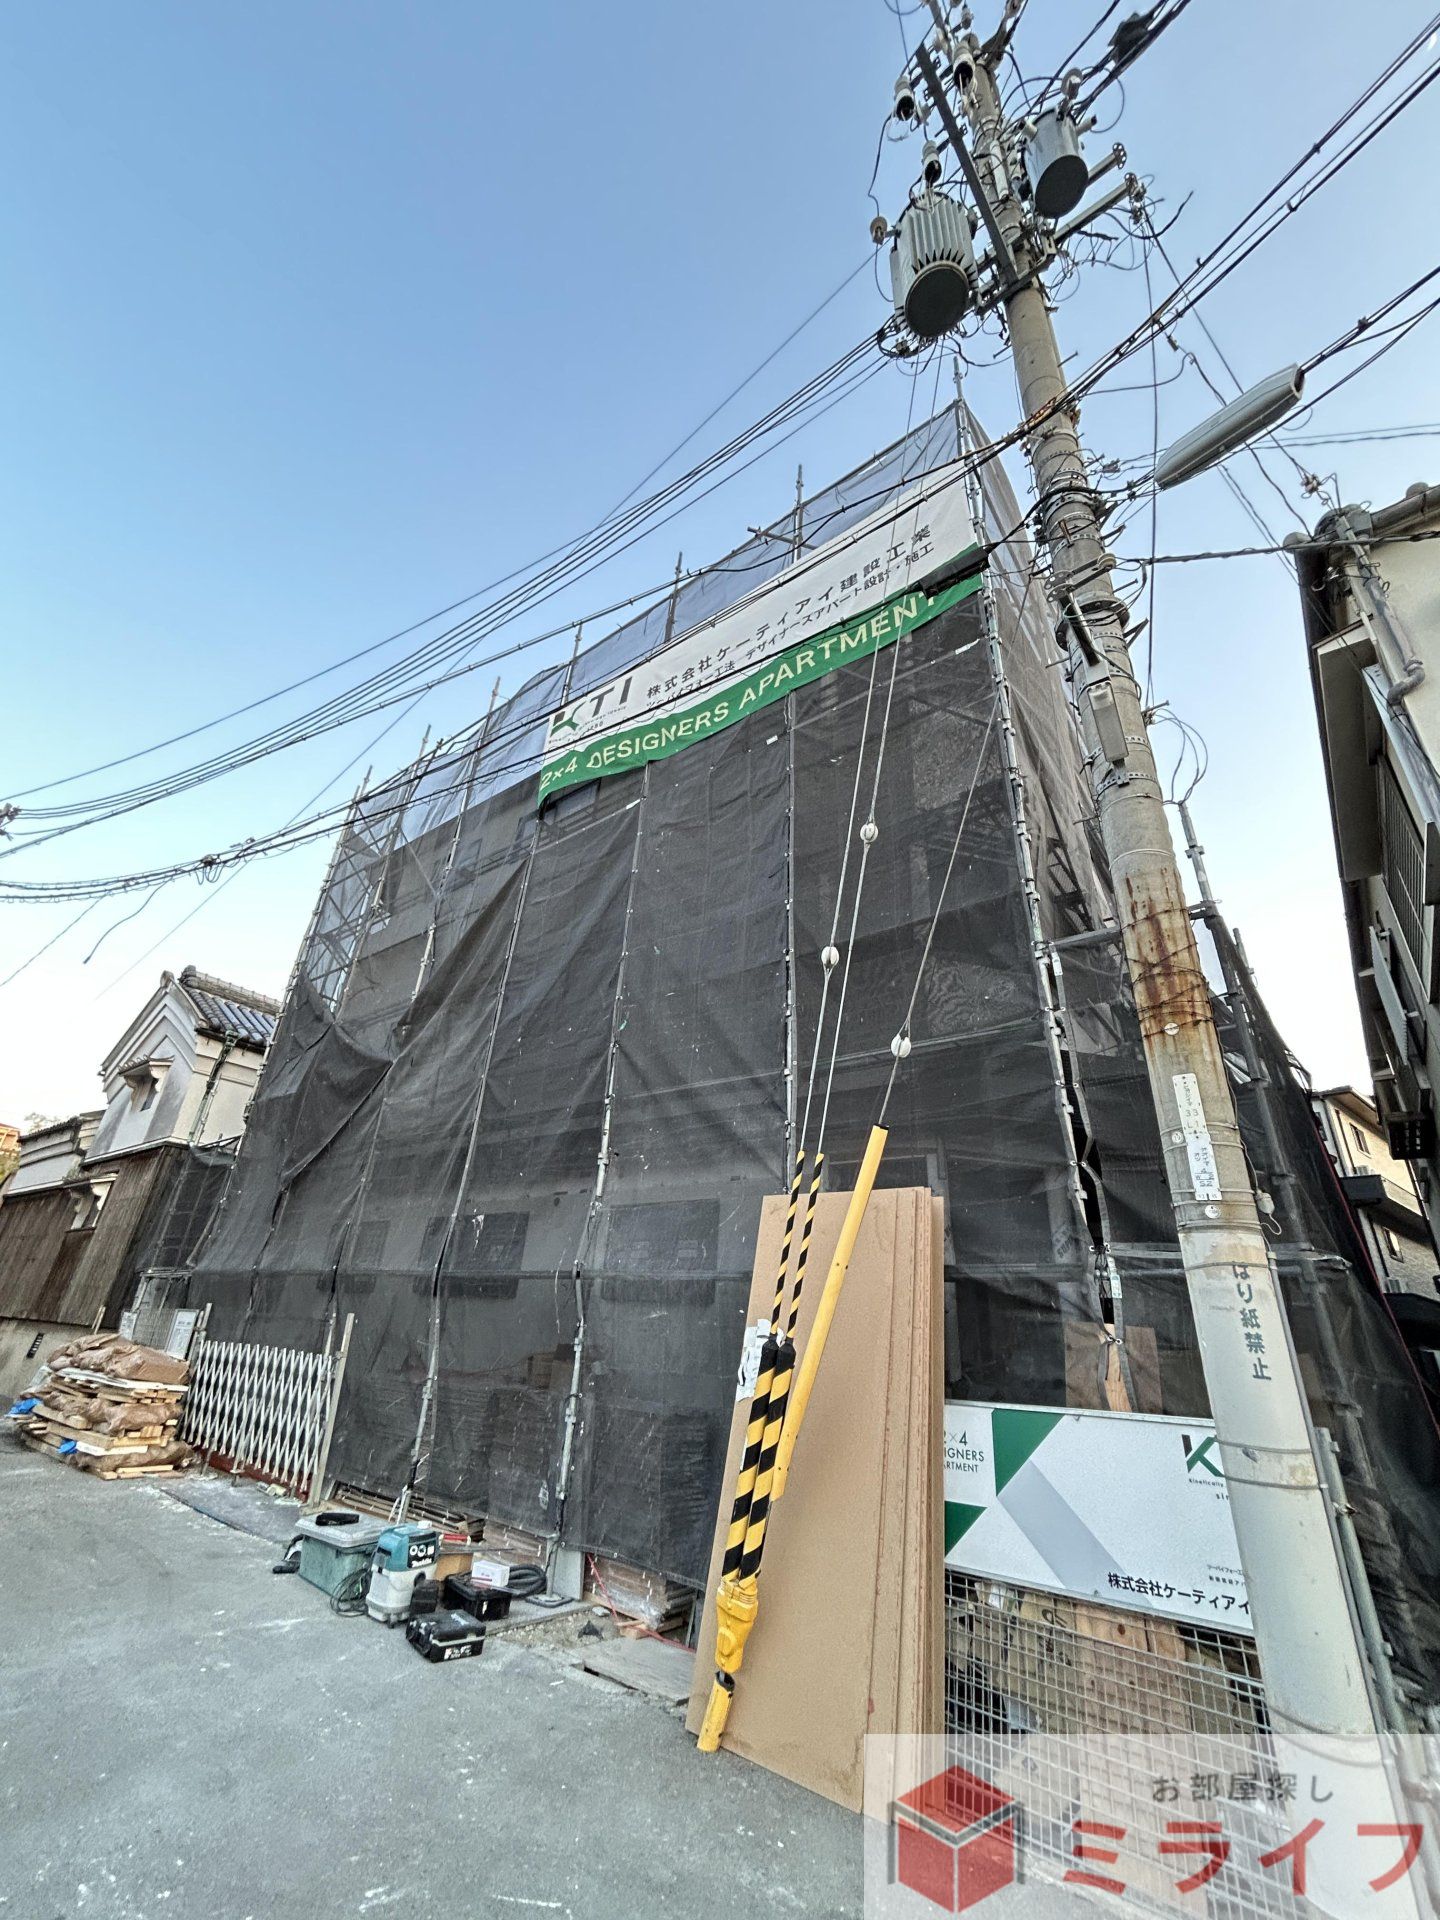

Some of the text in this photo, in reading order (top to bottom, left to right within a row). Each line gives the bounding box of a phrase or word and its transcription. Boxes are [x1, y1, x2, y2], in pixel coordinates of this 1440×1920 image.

[586, 701, 729, 769] DESIGNERS
[1232, 1262, 1272, 1381] はり紙禁止
[1107, 1571, 1250, 1615] 株式会社ケーティアイ
